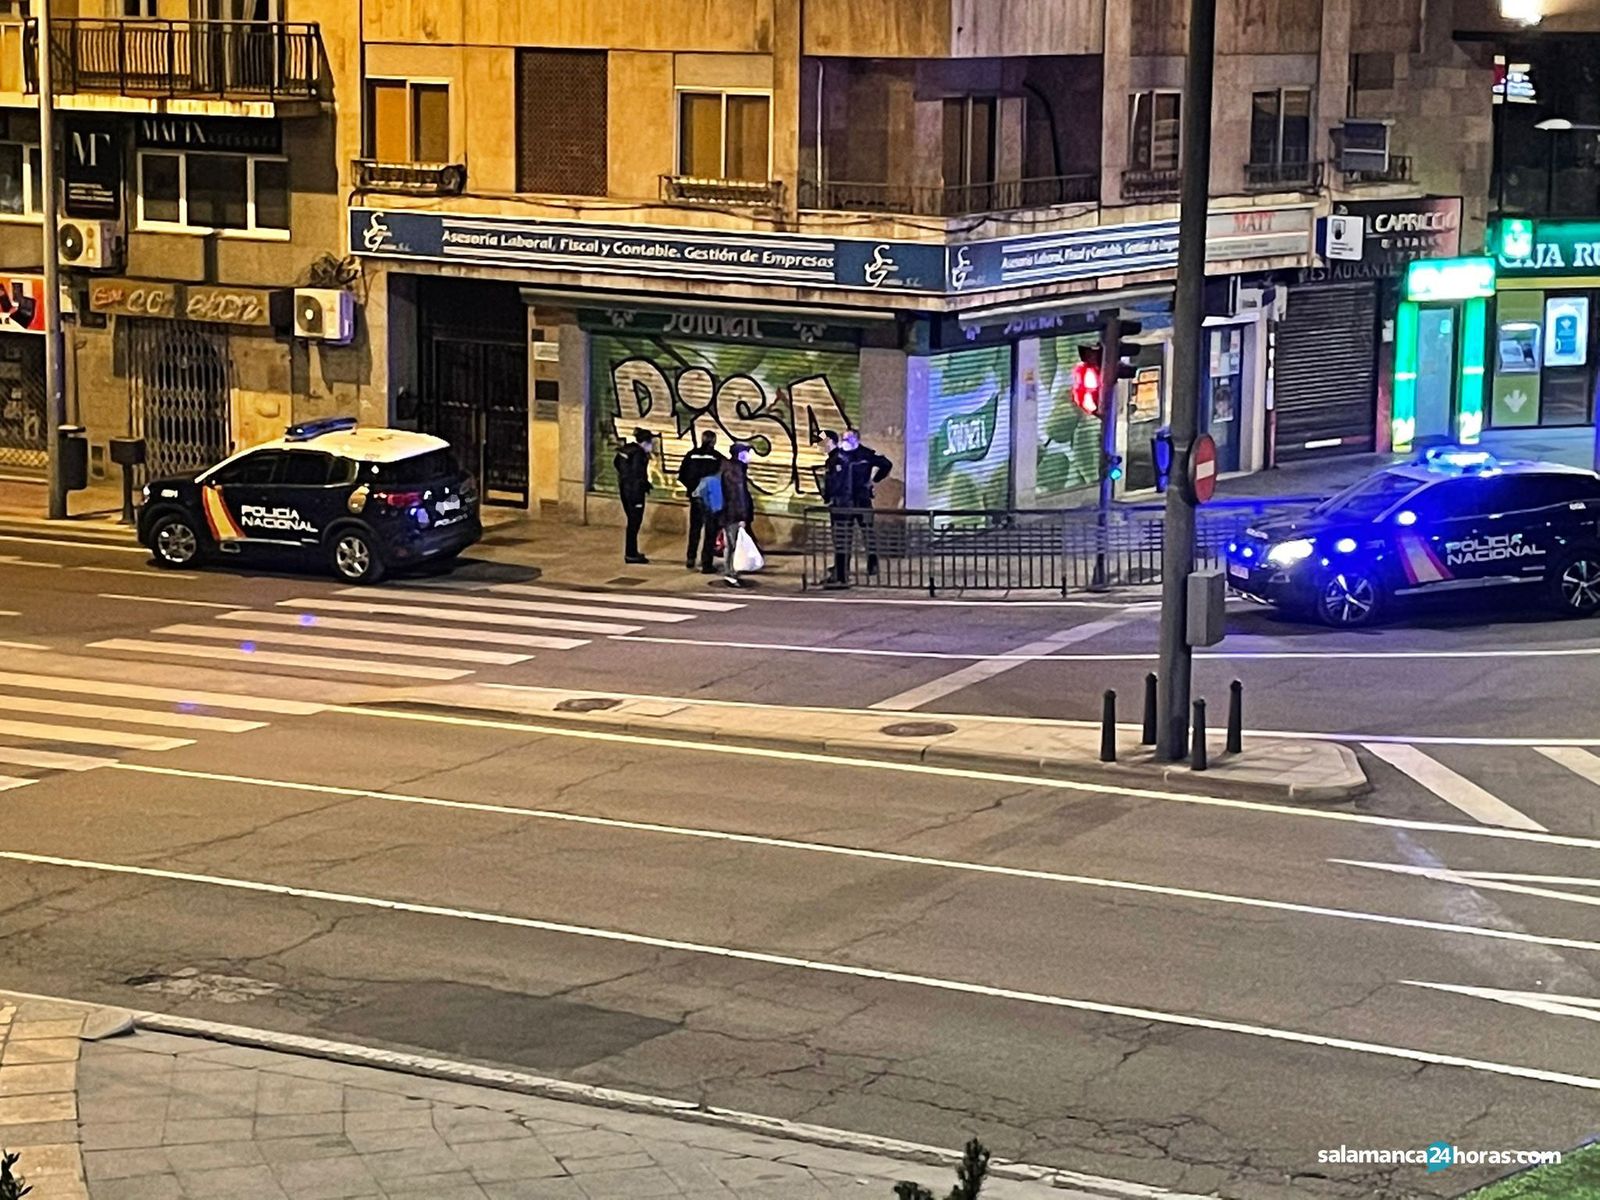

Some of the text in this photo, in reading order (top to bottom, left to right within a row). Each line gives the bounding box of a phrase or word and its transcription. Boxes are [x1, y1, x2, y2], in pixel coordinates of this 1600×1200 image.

[1375, 212, 1457, 233] CAPRICCIO
[441, 230, 834, 268] Asesoría Laboral, Fiscal y Contable. Gestión de Empresas
[241, 515, 319, 533] NACIONAL
[1447, 544, 1546, 566] NACIONAL
